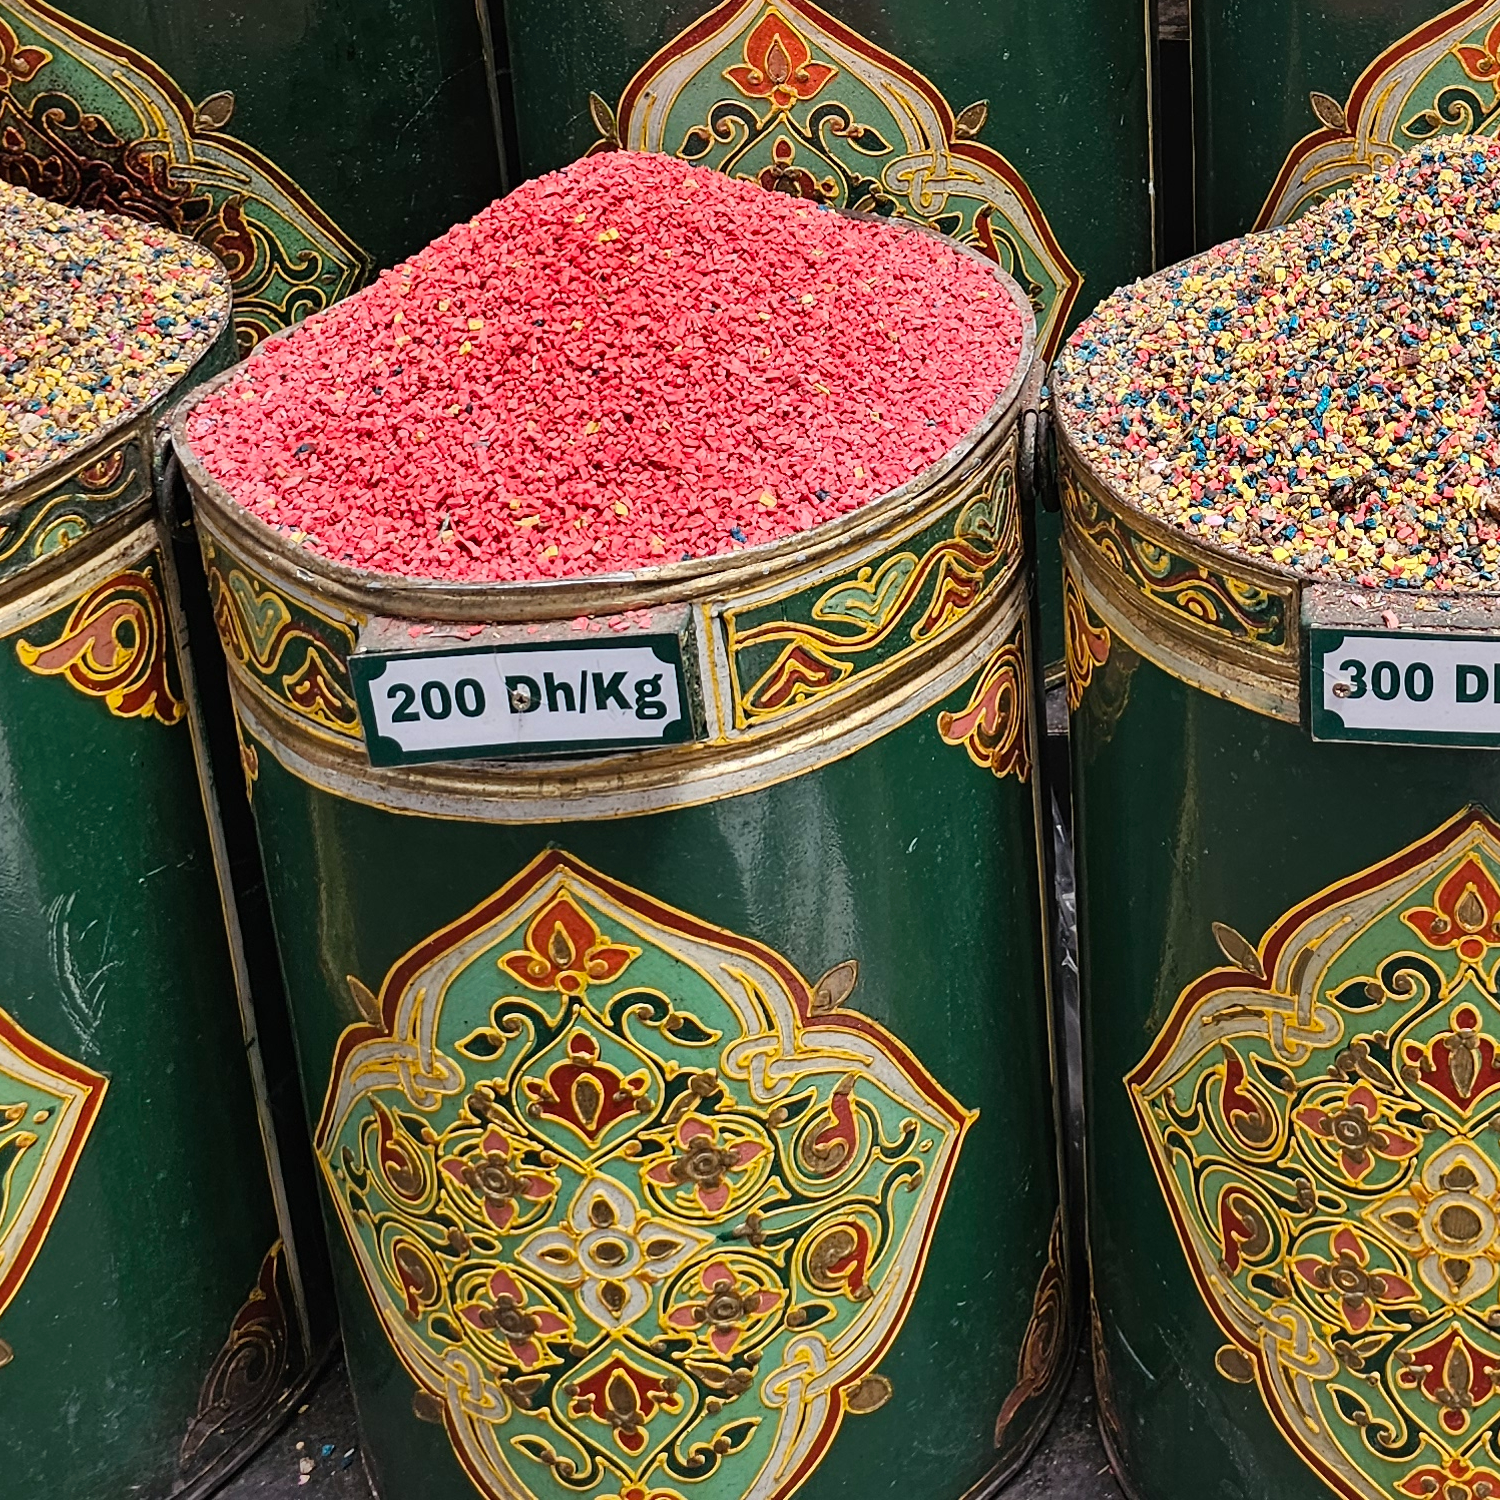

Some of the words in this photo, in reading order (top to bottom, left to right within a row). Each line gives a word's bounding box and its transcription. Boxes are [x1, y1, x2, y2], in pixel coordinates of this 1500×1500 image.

[386, 677, 486, 723] 200
[505, 669, 668, 720] Dh/Kg
[1339, 659, 1434, 702] 300
